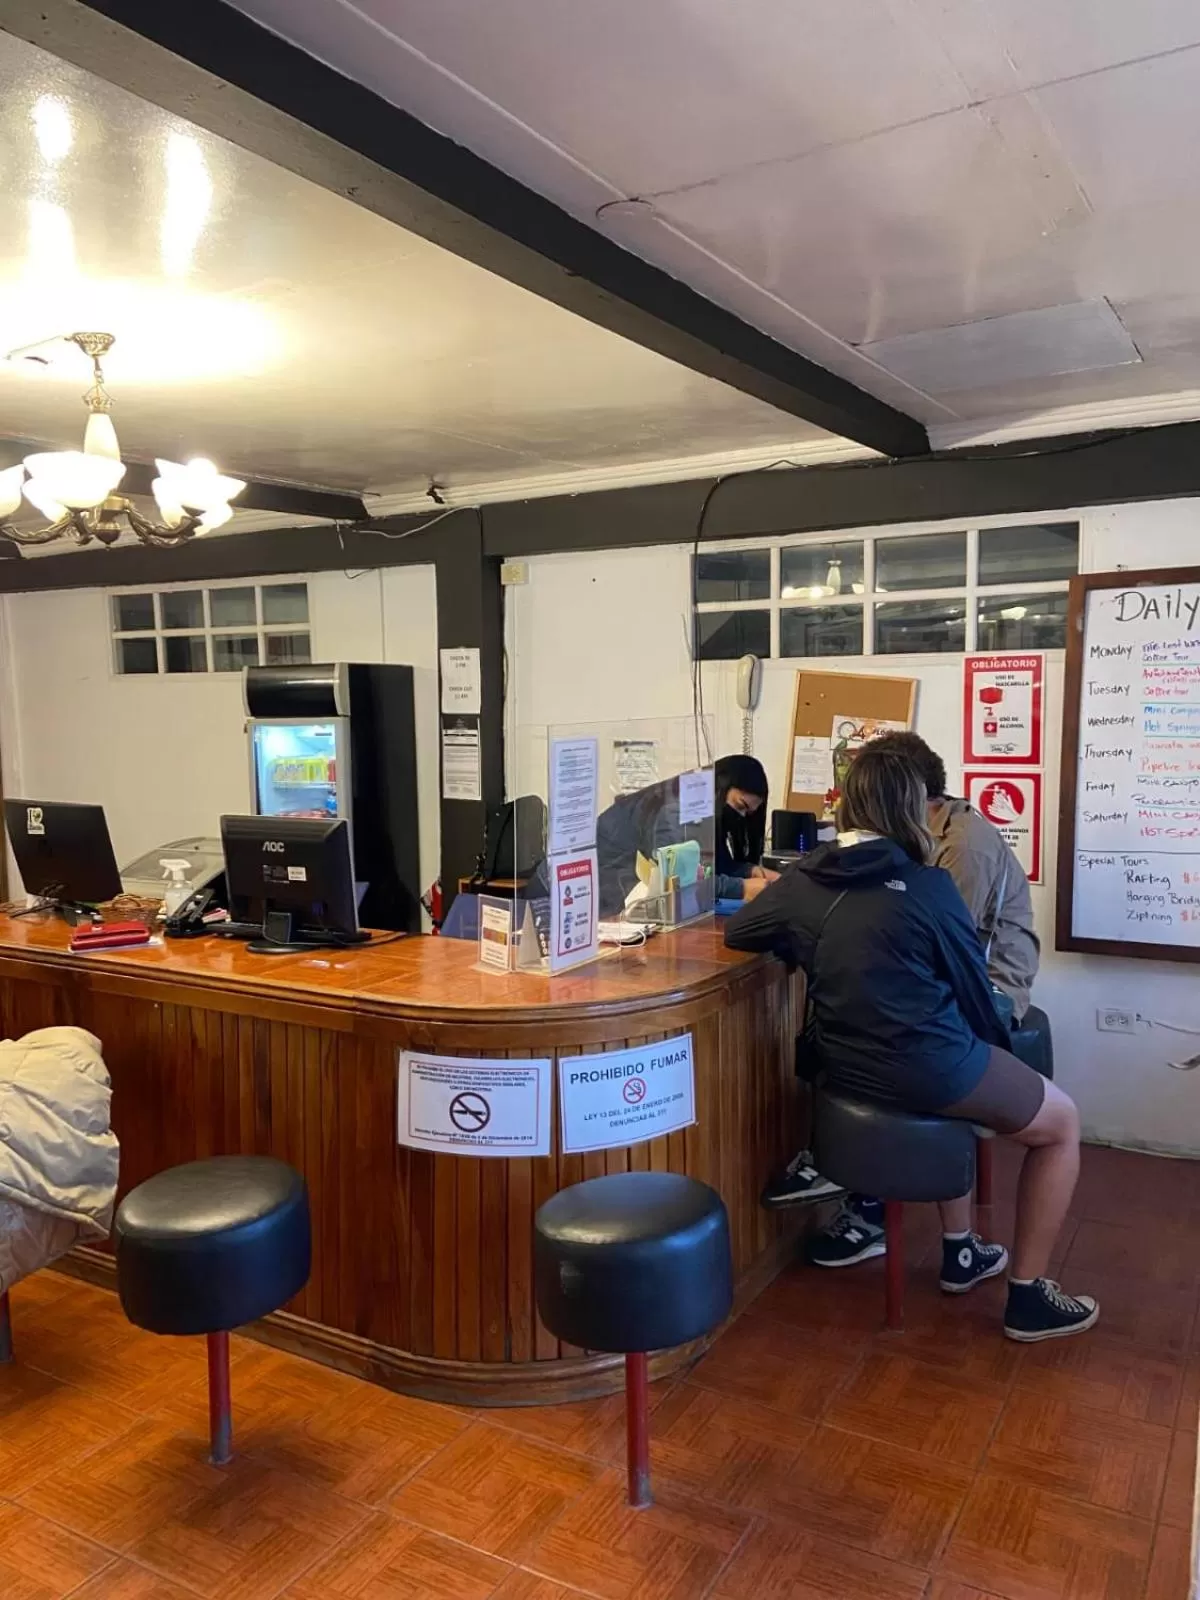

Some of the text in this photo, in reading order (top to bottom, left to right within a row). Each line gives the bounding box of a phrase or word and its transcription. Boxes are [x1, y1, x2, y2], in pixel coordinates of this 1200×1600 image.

[971, 659, 1037, 669] OBLIGATORIO
[262, 841, 285, 852] AOC
[570, 1049, 688, 1085] PROHIBIDO FUMAR
[584, 1112, 598, 1120] LEY
[608, 1109, 621, 1117] DEL
[642, 1100, 662, 1110] ENERO
[648, 1110, 656, 1118] AL
